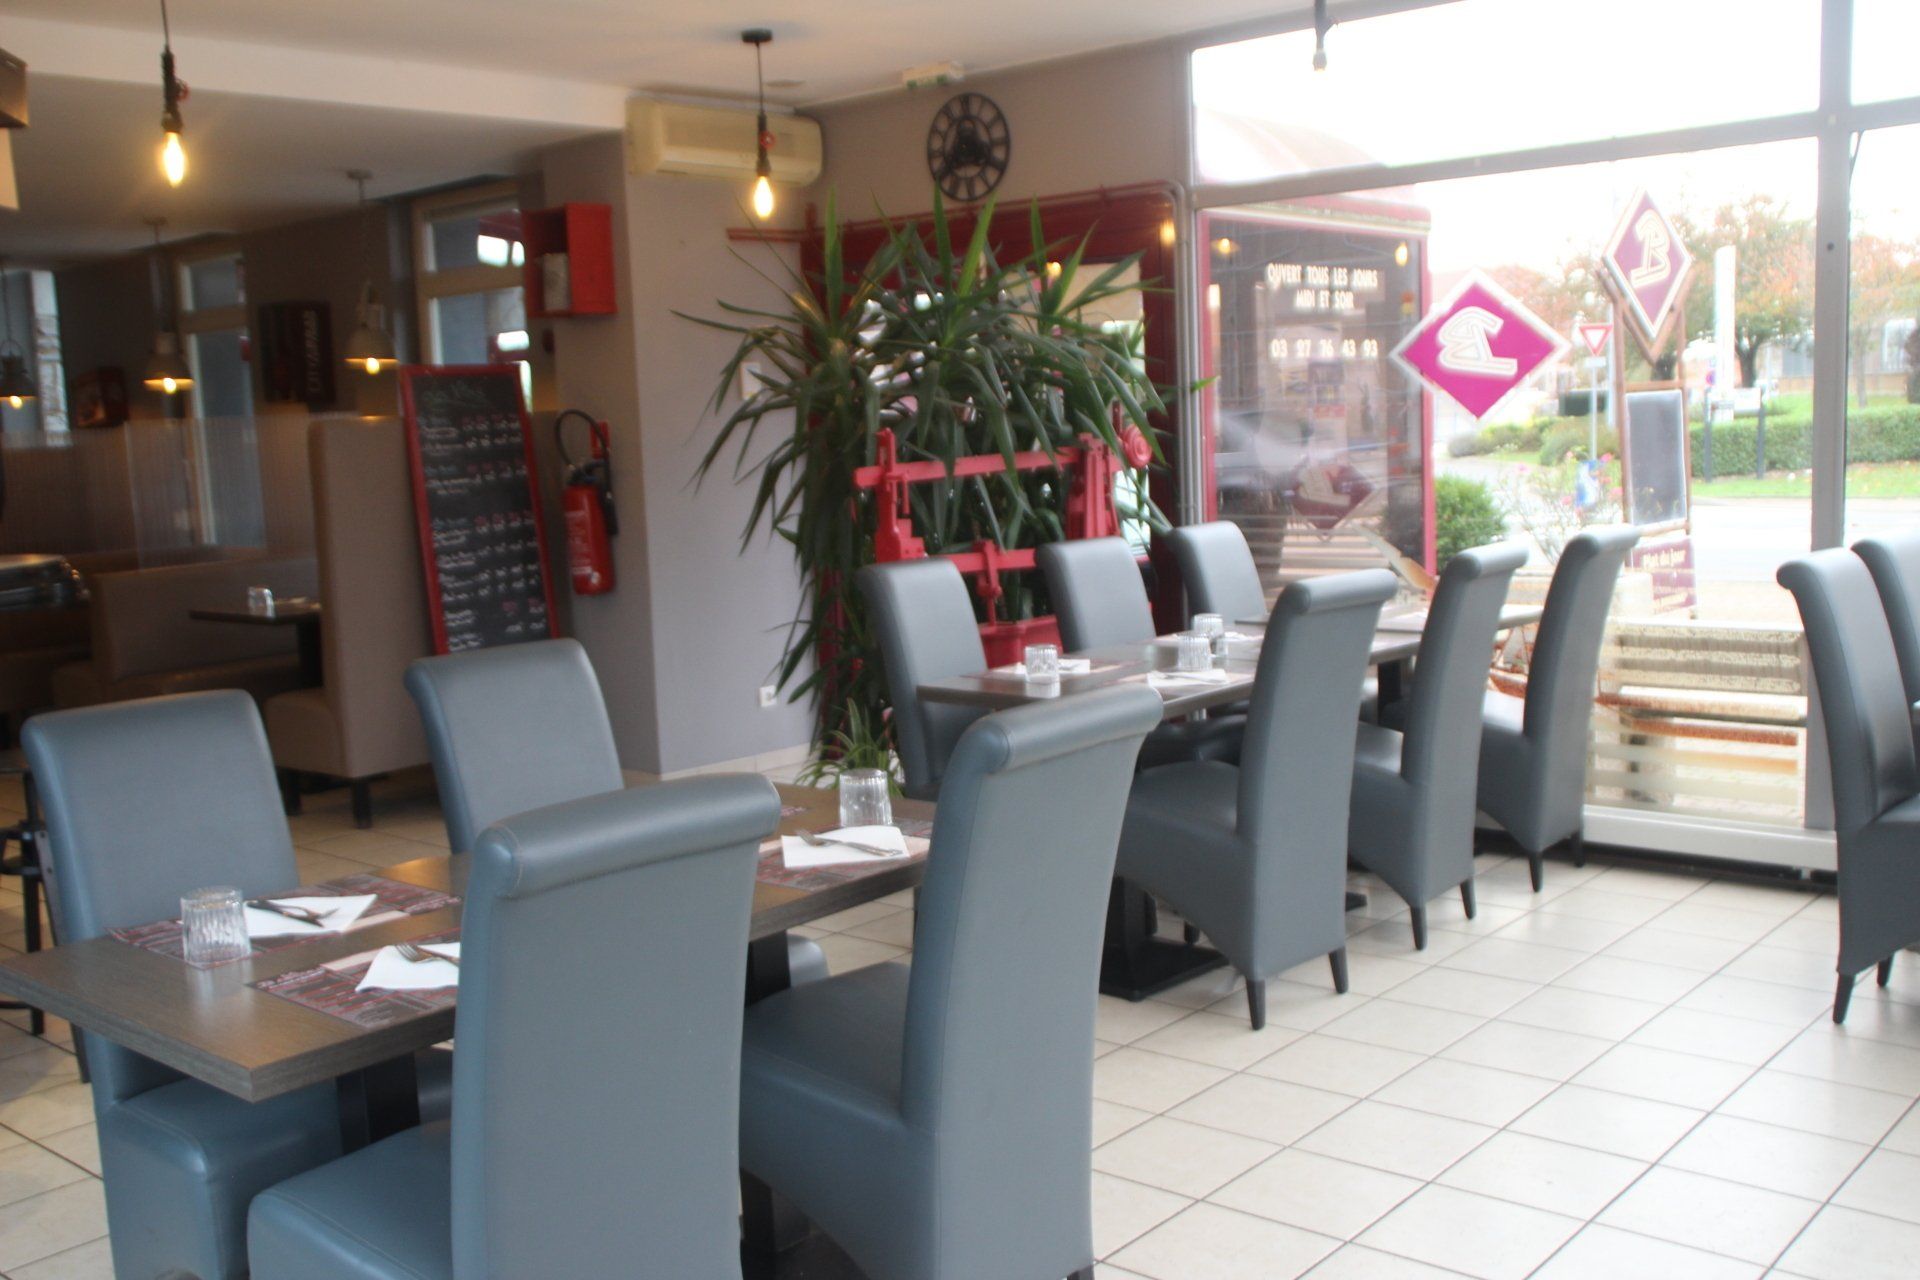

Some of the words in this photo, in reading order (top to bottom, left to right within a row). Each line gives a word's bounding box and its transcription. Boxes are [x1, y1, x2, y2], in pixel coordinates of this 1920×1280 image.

[1267, 263, 1302, 283] OUVERT
[1306, 265, 1329, 284] TOUS
[1333, 267, 1348, 285] LES
[1353, 268, 1378, 287] JOURS
[1296, 289, 1315, 307] MIDI
[1320, 290, 1330, 307] ET
[1335, 290, 1354, 308] SOIR
[1271, 338, 1288, 358] 03
